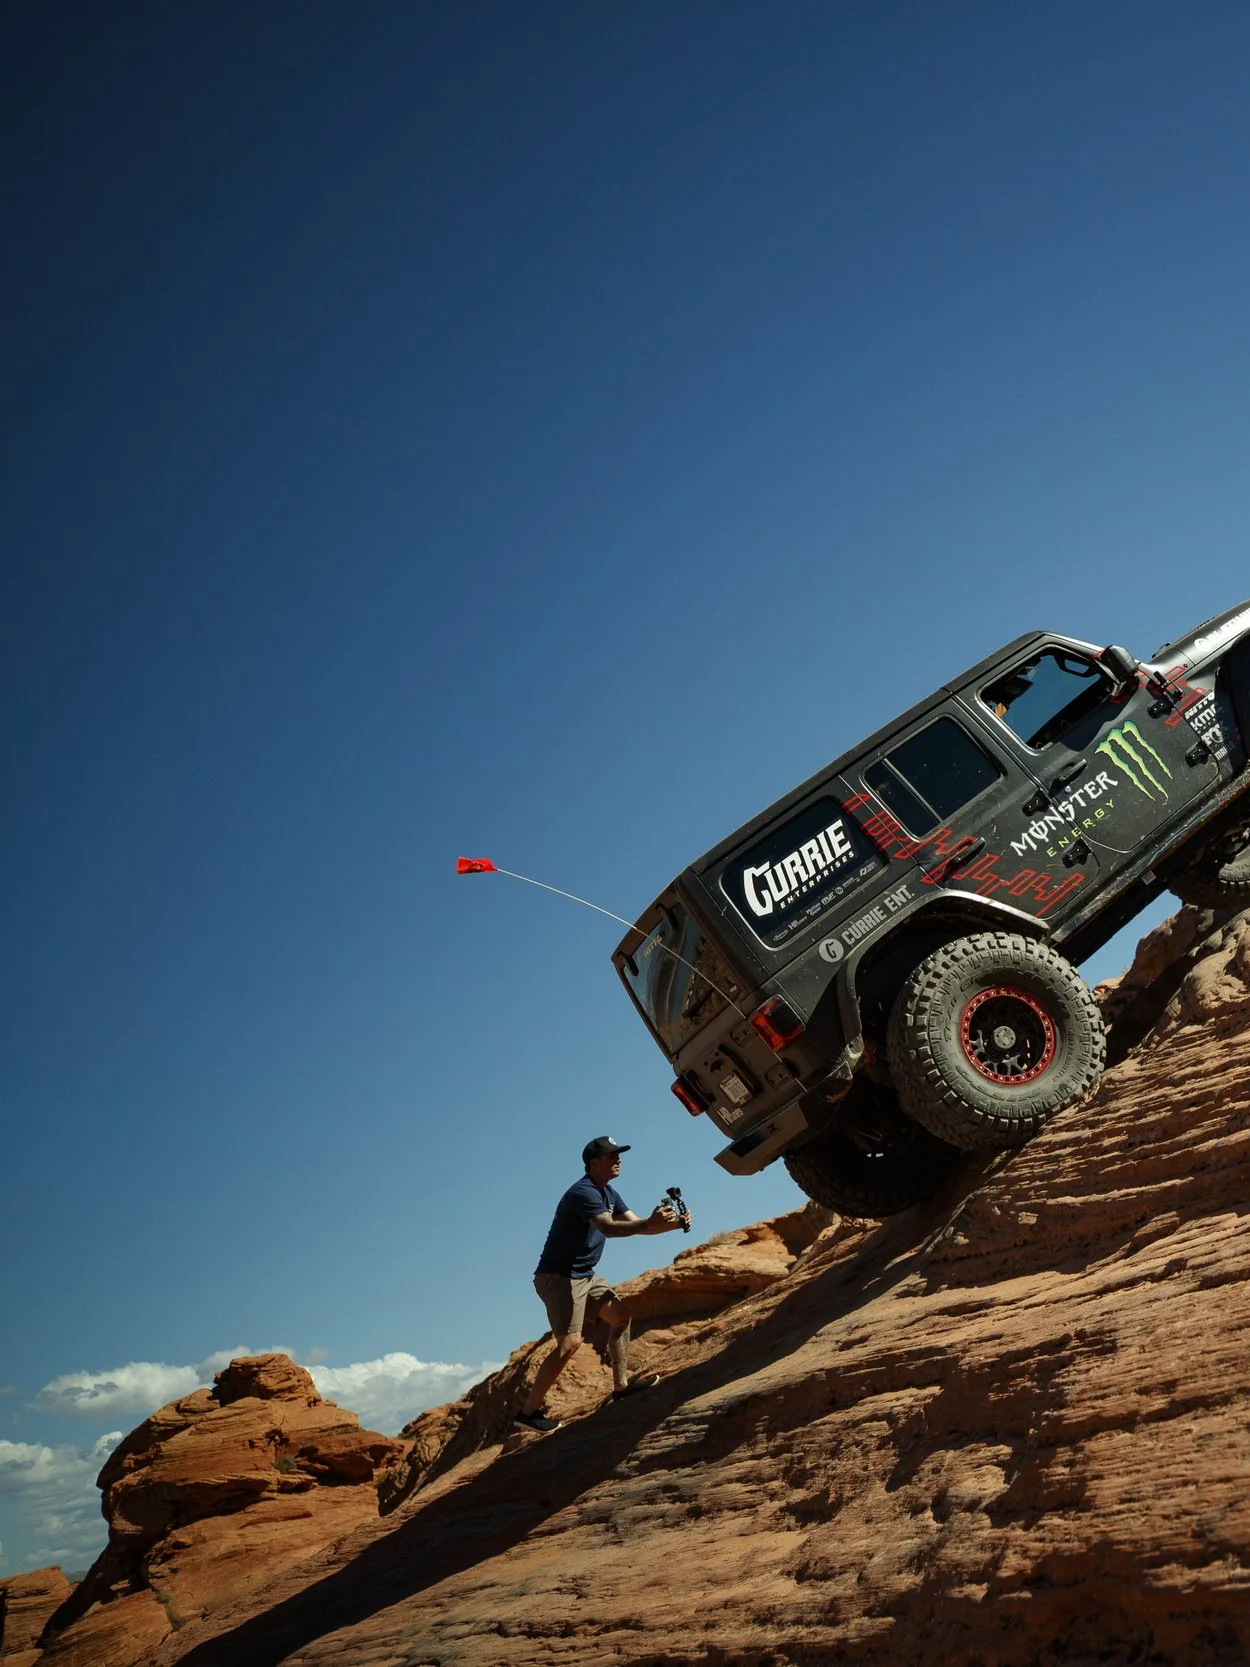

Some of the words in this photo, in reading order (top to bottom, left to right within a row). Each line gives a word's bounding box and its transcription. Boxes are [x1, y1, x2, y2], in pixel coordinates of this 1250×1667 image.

[1010, 771, 1118, 857] MONSTER
[1046, 799, 1115, 858] ENERGY
[743, 819, 852, 917] CURRIE
[780, 851, 854, 909] ENTERPRISES
[841, 905, 888, 945] CURRIE
[883, 884, 915, 912] ENT.
